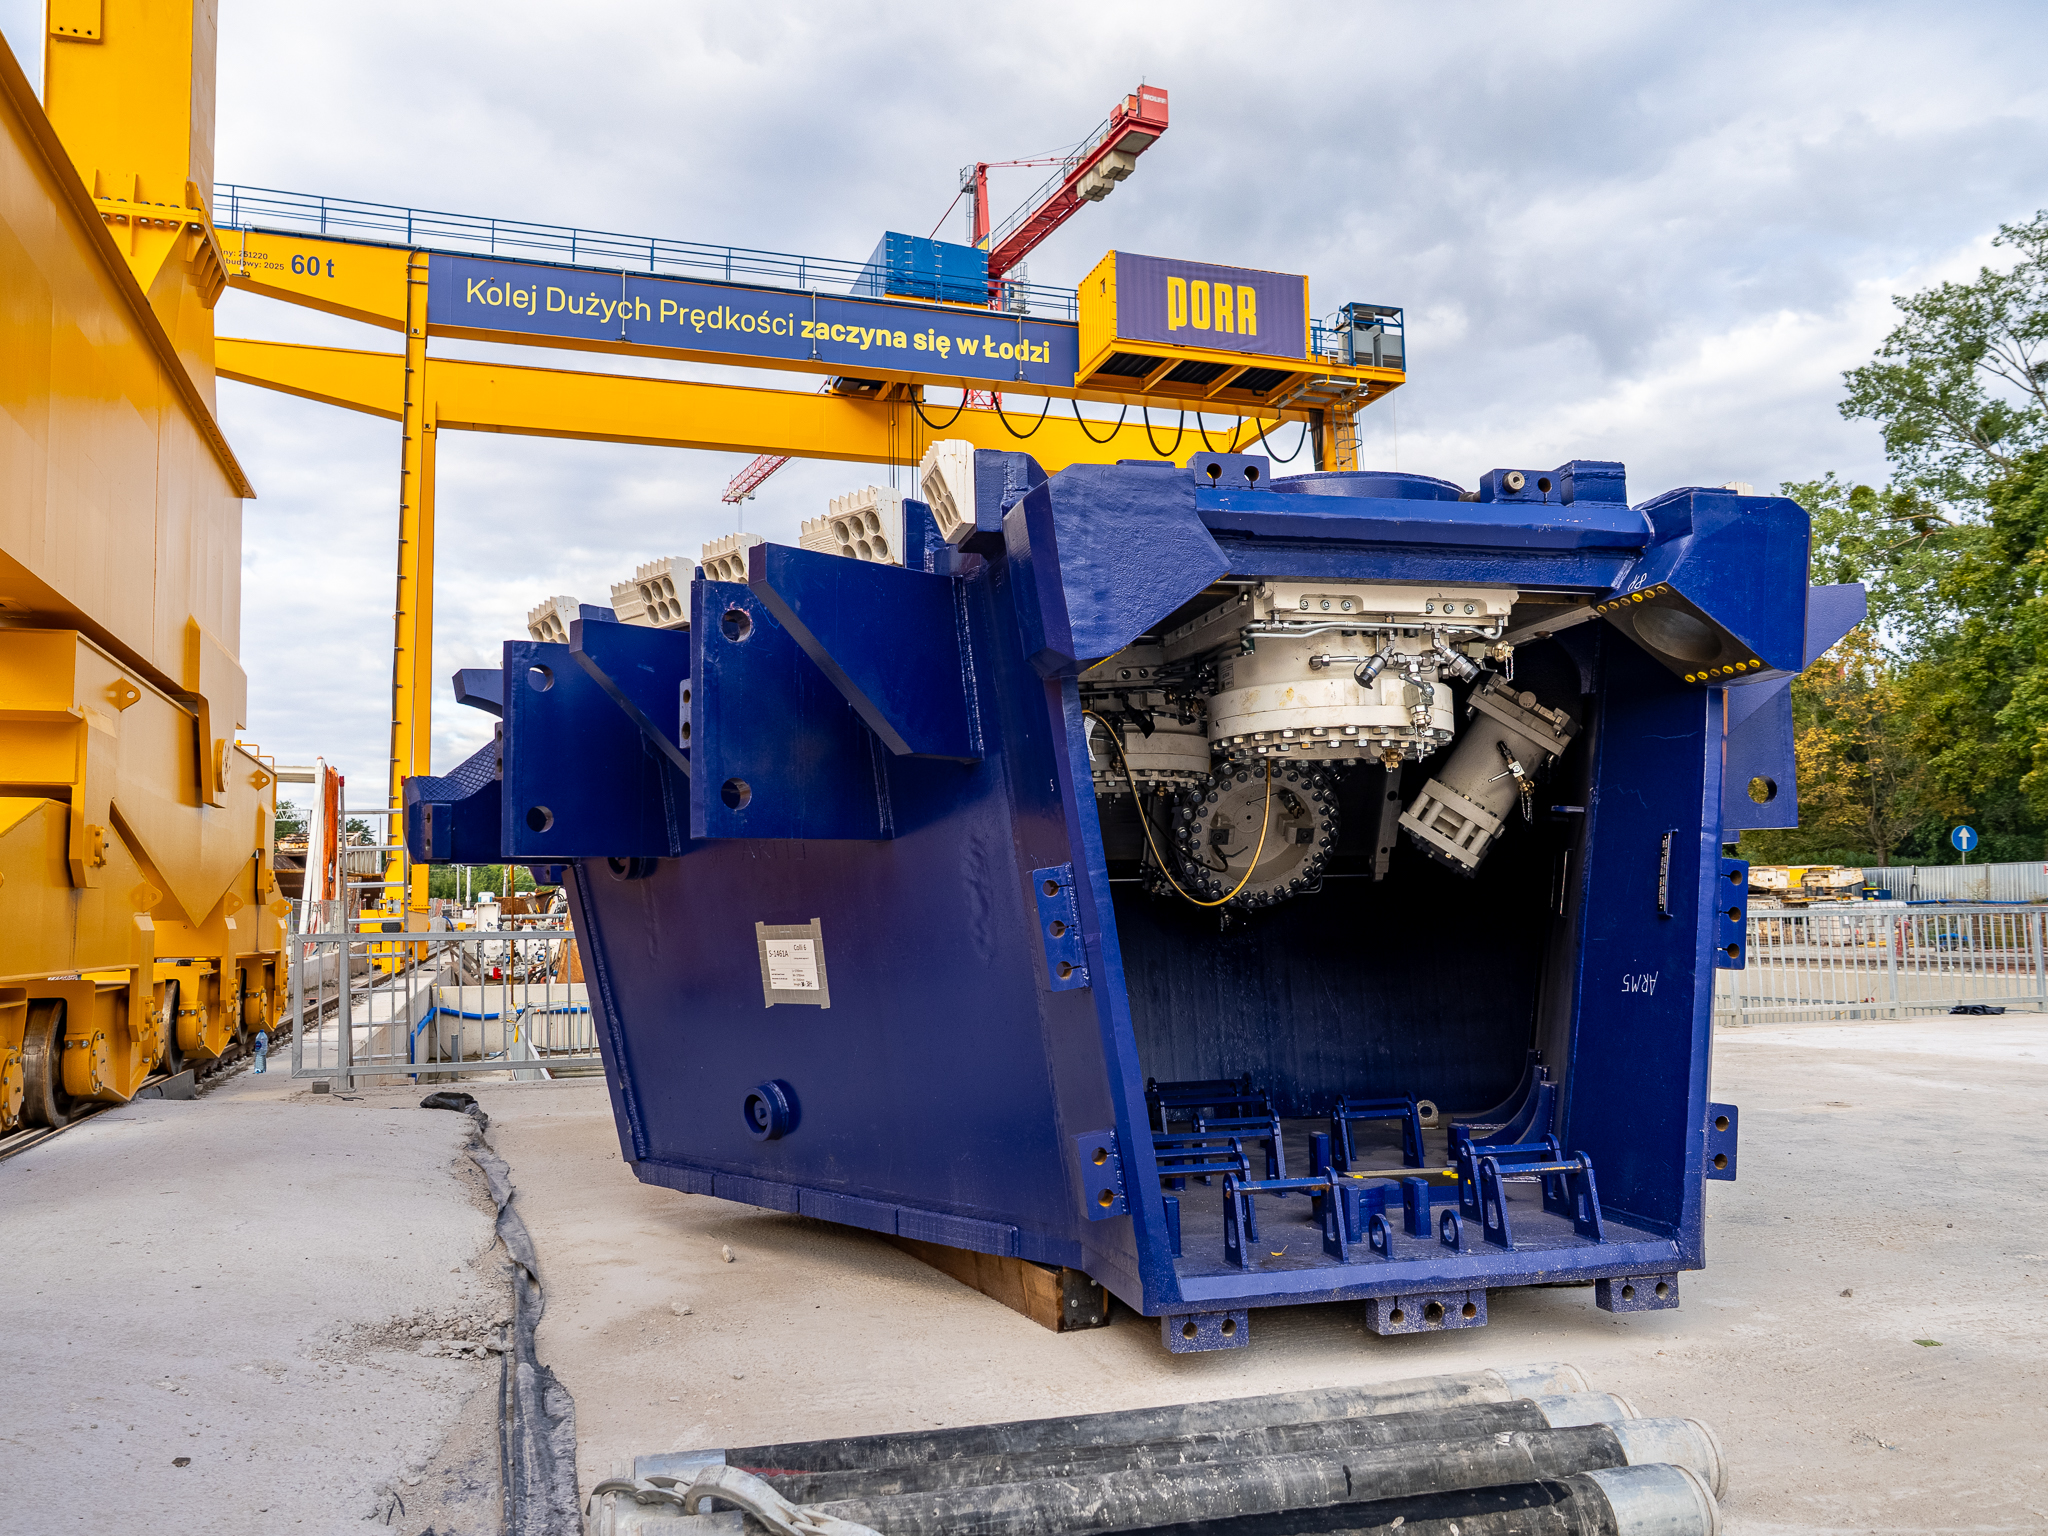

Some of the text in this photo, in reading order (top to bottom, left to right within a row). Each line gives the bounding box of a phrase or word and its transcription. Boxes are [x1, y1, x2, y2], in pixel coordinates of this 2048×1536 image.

[1143, 94, 1167, 104] WOLFF
[264, 262, 285, 270] 2025
[291, 254, 335, 278] 60 t
[1167, 276, 1257, 336] PORR
[466, 277, 1051, 364] Kolej Dużych Prędkości zaczyna się w Łodzi
